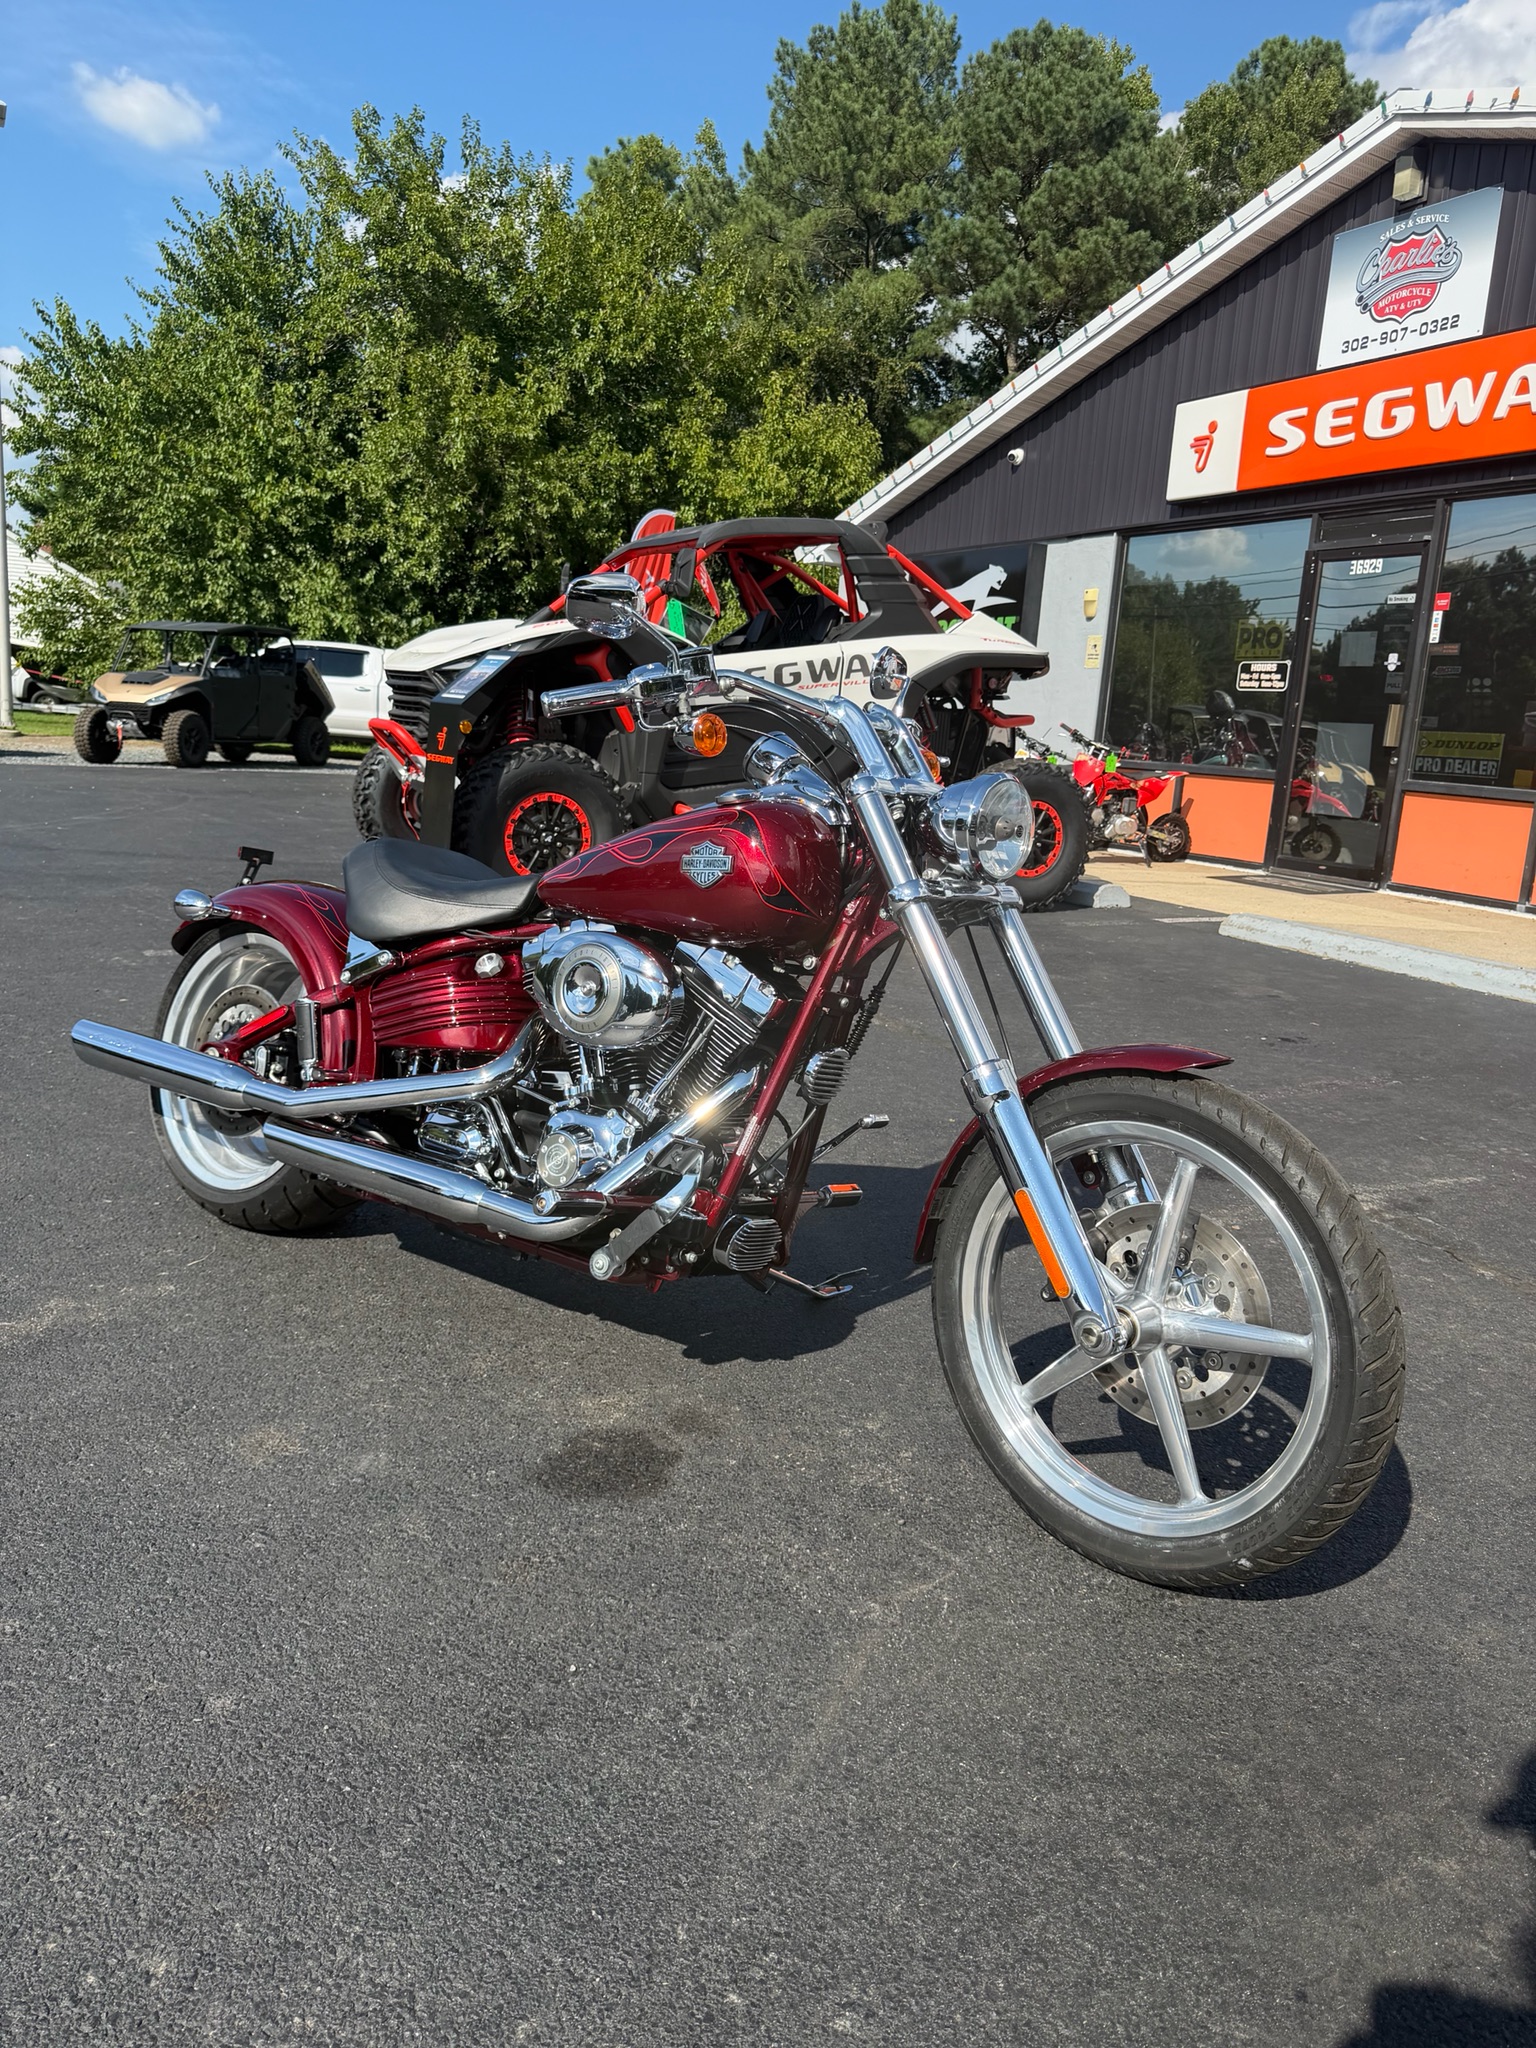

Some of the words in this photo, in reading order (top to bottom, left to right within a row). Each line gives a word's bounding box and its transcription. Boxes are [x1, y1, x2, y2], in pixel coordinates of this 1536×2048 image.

[1380, 222, 1406, 243] SALES
[1406, 219, 1414, 228] &
[1415, 213, 1450, 226] SERVICE
[1356, 234, 1461, 293] Charlie's
[1377, 287, 1432, 310] MOTORCYCLE
[1384, 303, 1399, 314] ATV
[1400, 302, 1405, 310] &
[1406, 298, 1423, 308] UTV
[1341, 314, 1460, 354] 302-907-0322
[1349, 558, 1384, 575] 36929
[1238, 626, 1283, 649] PRO
[1251, 664, 1277, 672] HOURS
[1433, 740, 1501, 751] DUNLOP
[426, 753, 455, 765] SEGWAY
[1414, 757, 1442, 772] PRO
[1444, 758, 1498, 776] DEALER
[694, 845, 718, 856] MOTOR
[683, 858, 728, 869] HARLEY-DAVIDSON
[692, 871, 716, 884] CYCLES
